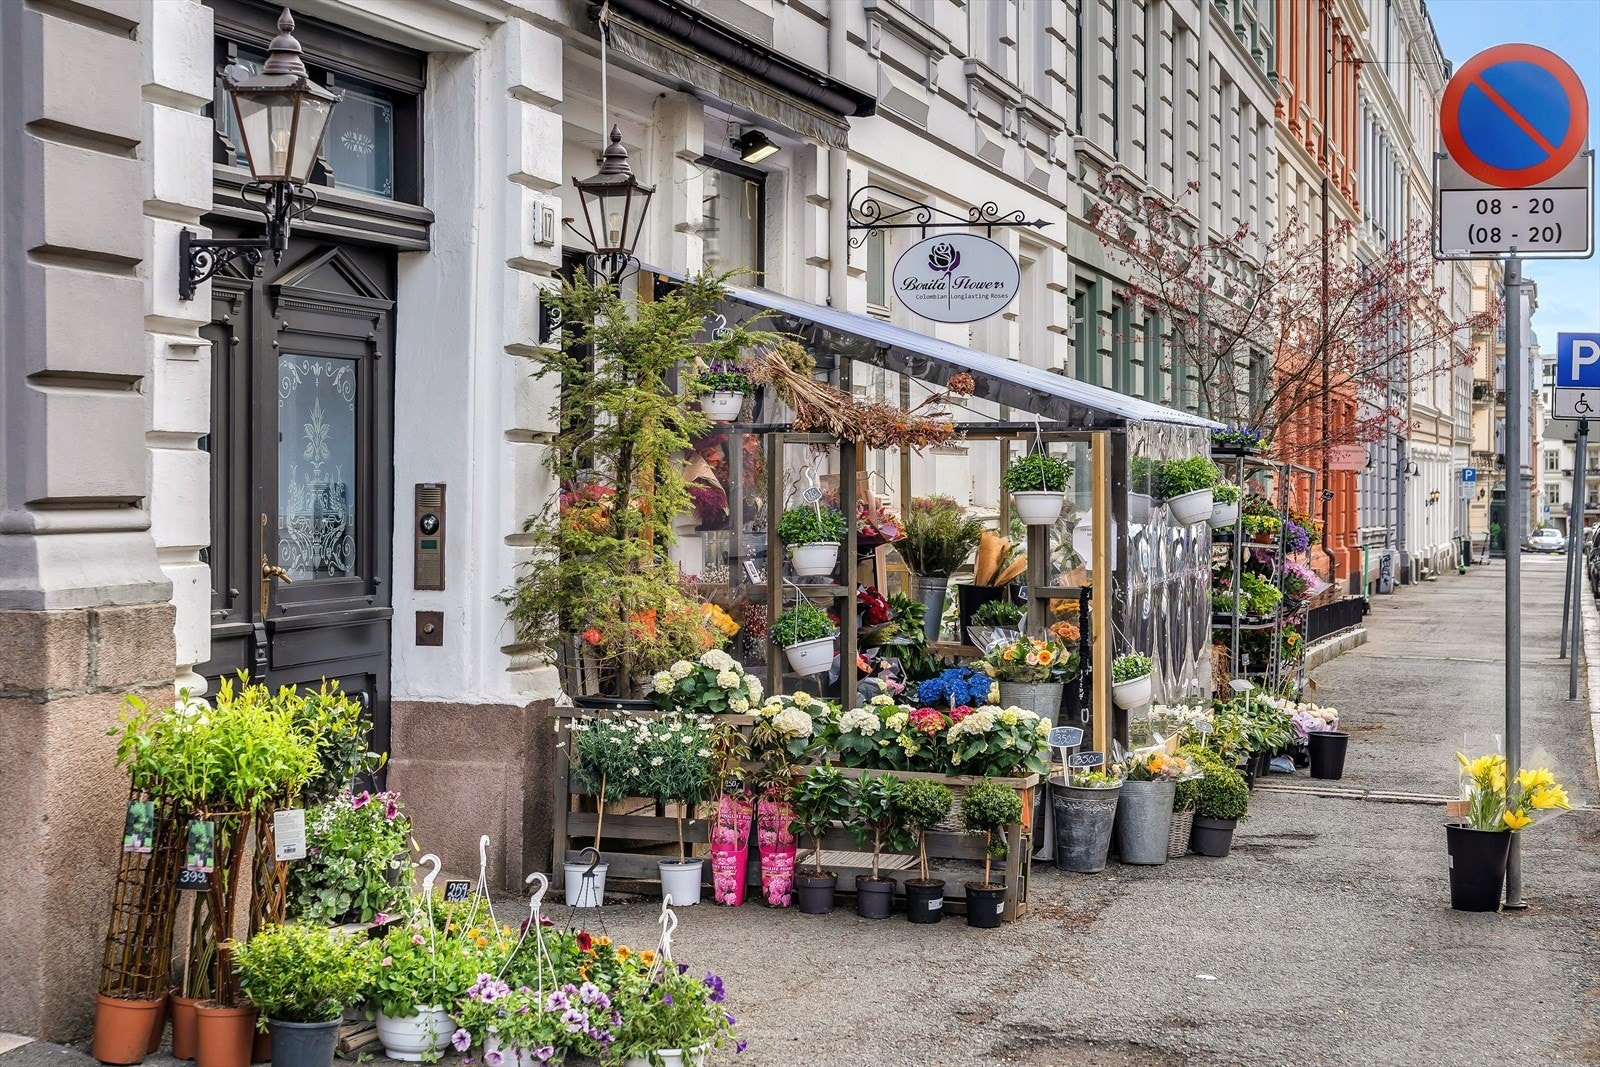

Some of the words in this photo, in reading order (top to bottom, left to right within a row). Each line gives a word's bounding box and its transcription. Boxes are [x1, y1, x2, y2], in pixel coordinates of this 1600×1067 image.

[1476, 199, 1502, 215] 08
[1528, 198, 1554, 214] 20
[544, 212, 552, 238] 17
[1468, 223, 1501, 245] (08
[1528, 222, 1562, 244] 20)
[900, 276, 947, 291] Bonita
[951, 275, 1004, 290] Flowers
[950, 292, 989, 301] Longlasting
[1571, 339, 1600, 380] P
[1465, 469, 1473, 480] P
